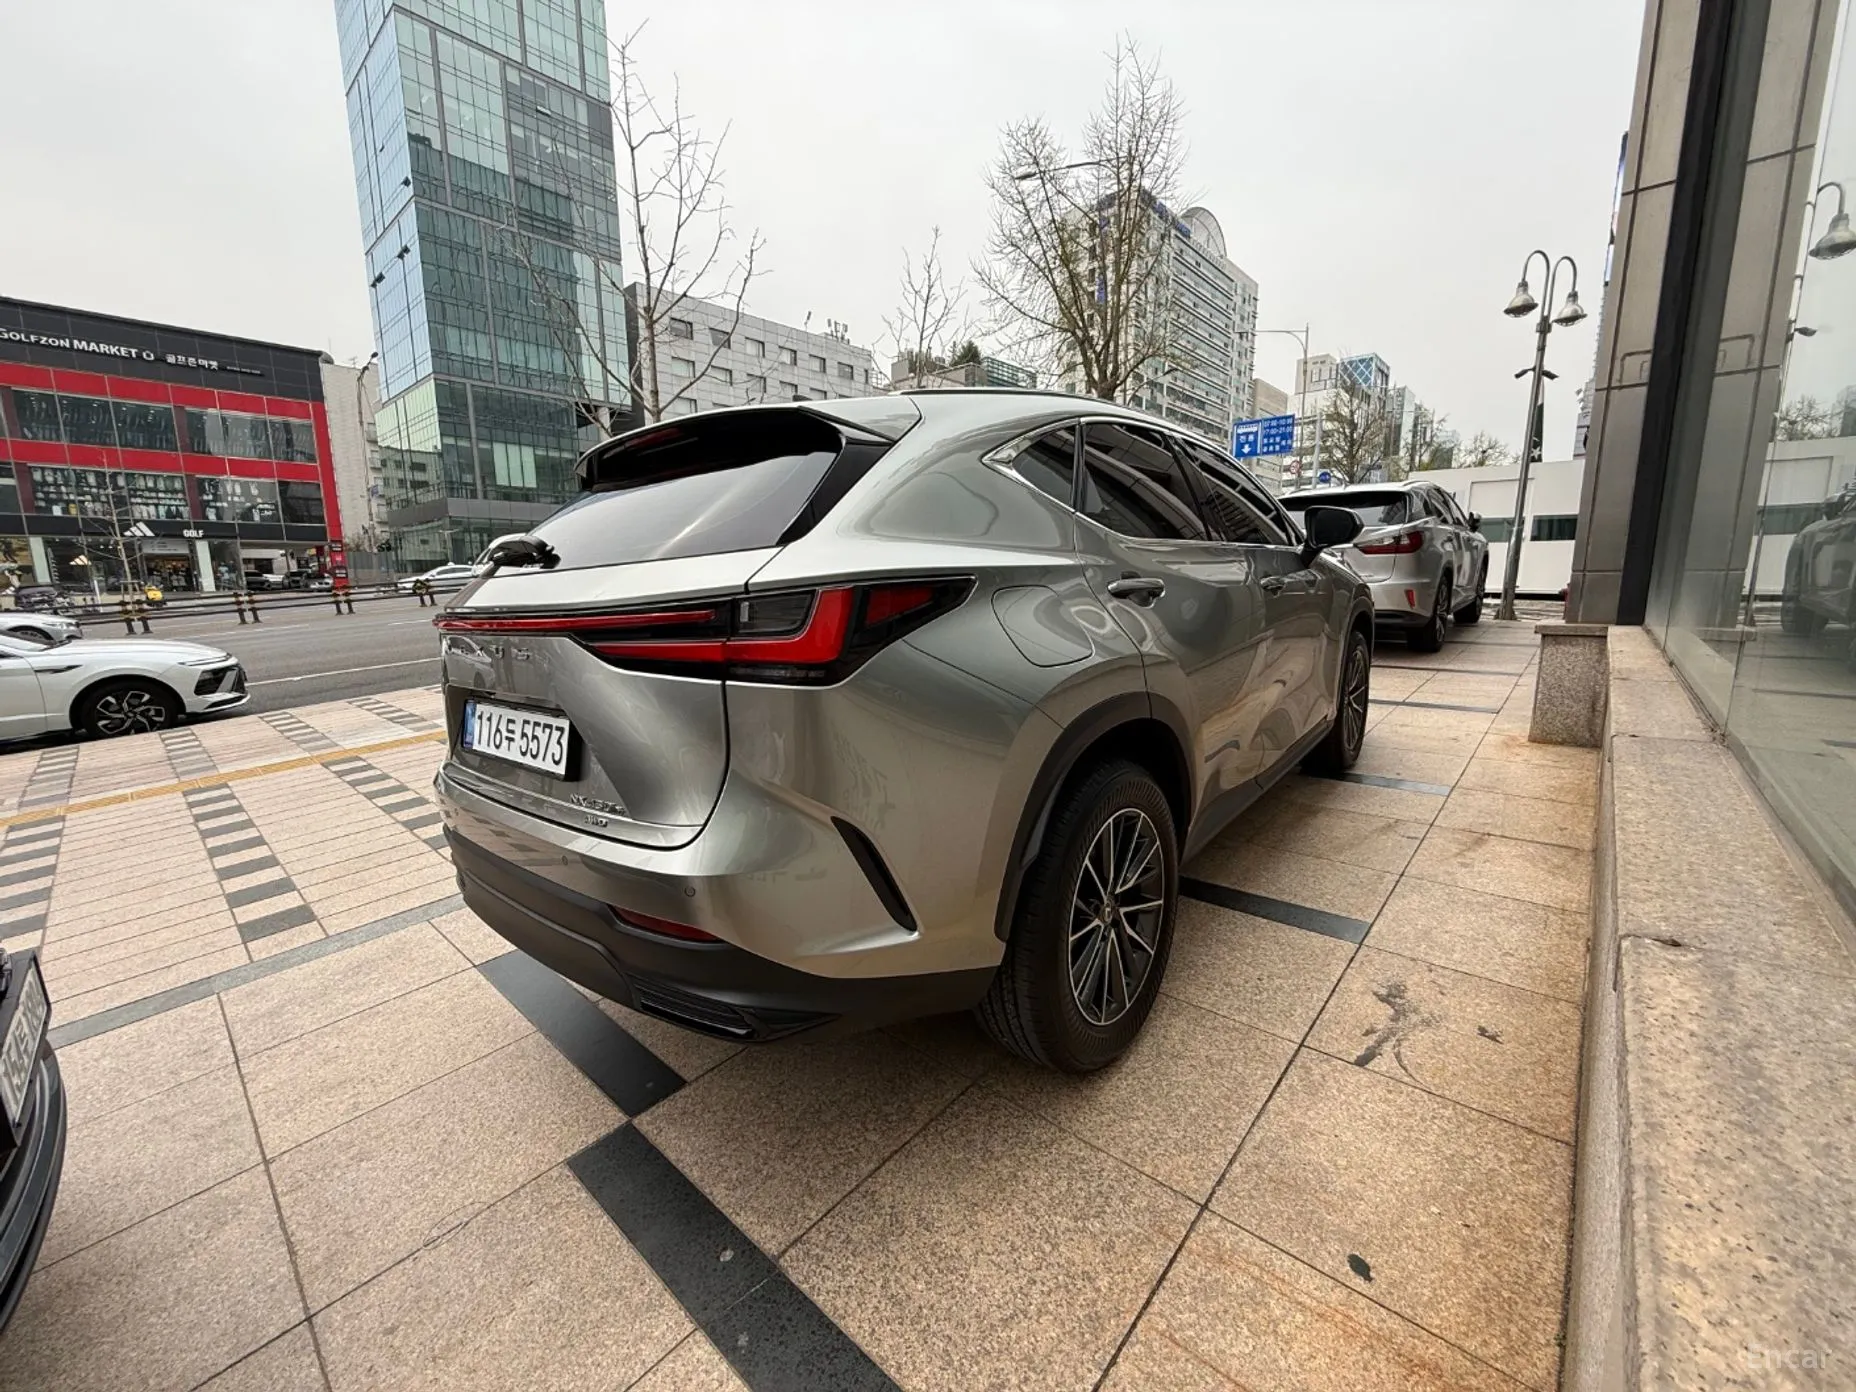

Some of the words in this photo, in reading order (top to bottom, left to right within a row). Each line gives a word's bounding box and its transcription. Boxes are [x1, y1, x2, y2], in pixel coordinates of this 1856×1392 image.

[0, 328, 70, 348] GOLFZON
[73, 339, 138, 358] MARKET
[182, 529, 204, 538] GOLF
